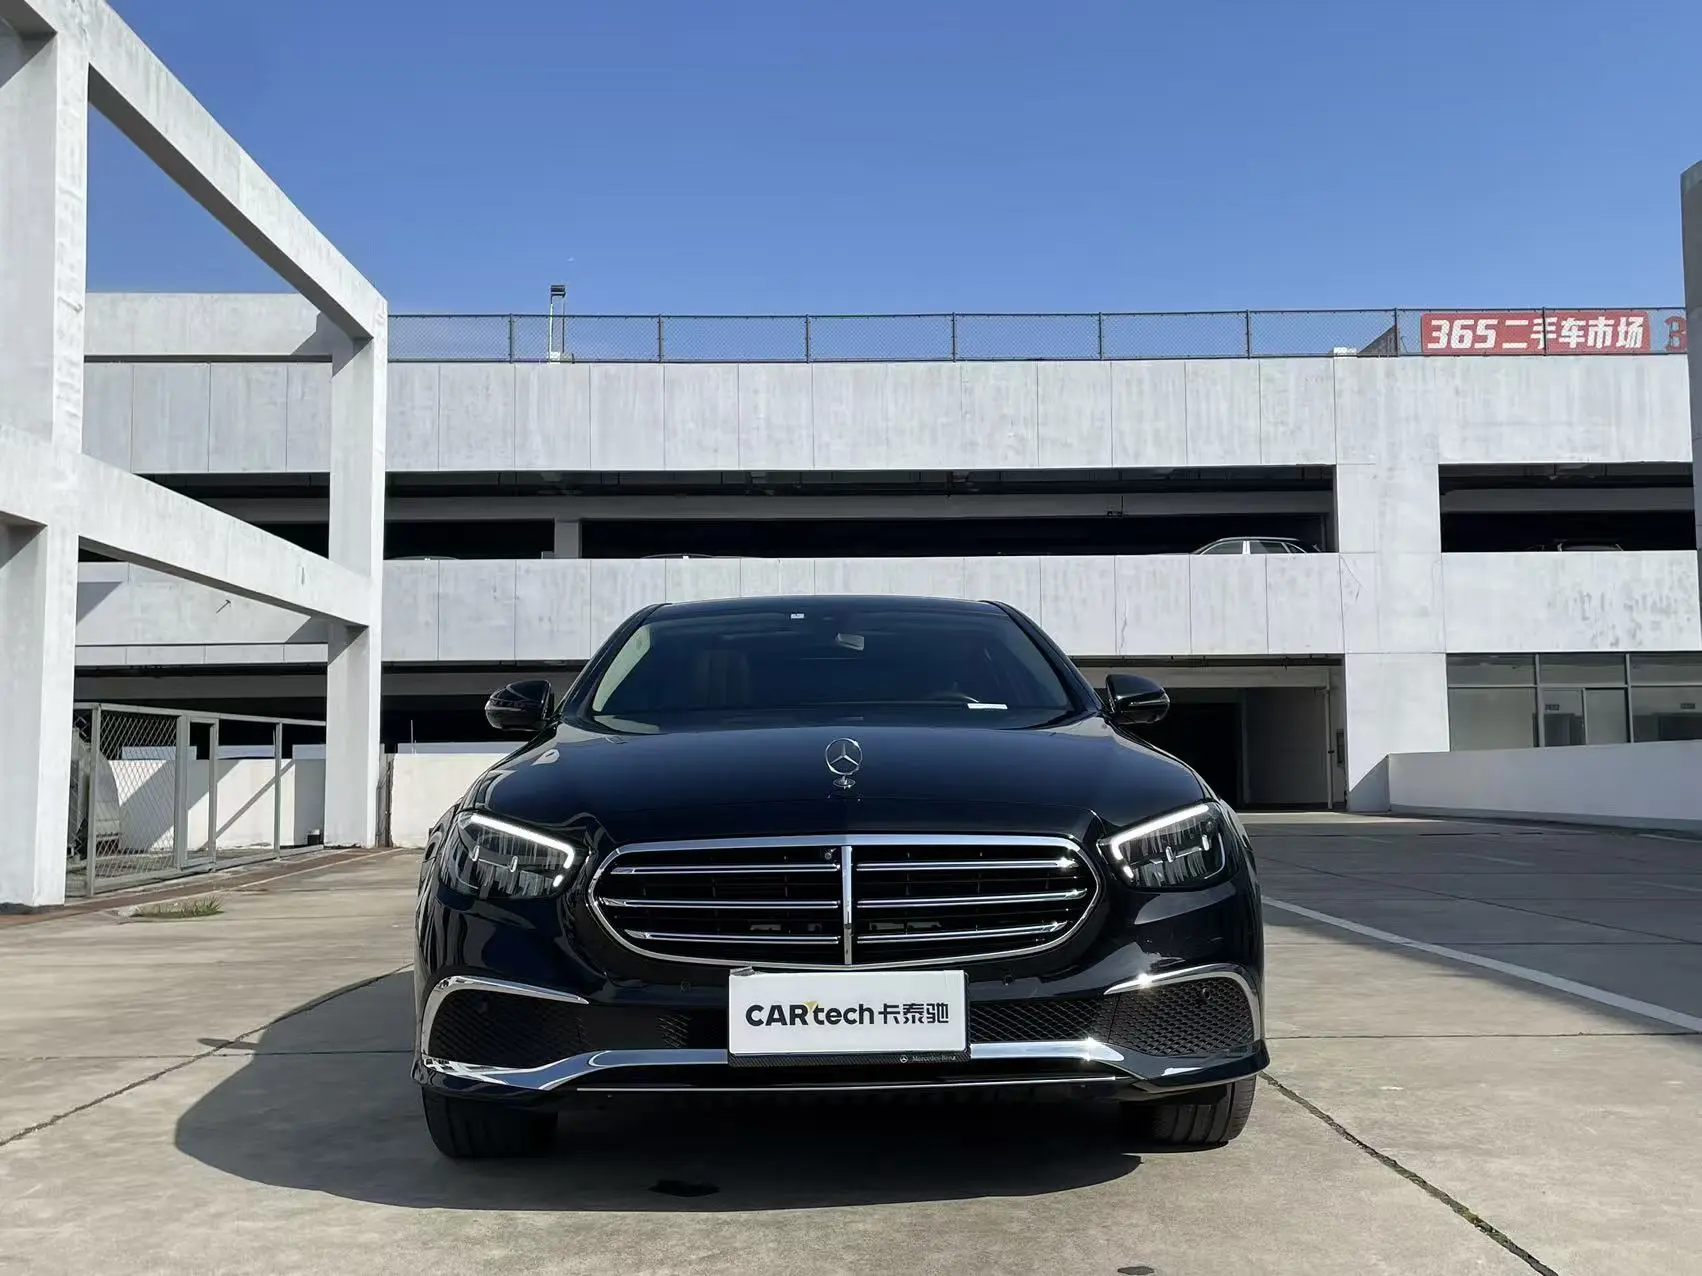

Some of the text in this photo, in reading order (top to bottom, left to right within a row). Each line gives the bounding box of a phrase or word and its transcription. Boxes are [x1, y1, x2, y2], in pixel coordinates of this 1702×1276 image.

[1427, 316, 1645, 350] 365二手车市场
[878, 1002, 949, 1025] 卡泰驰
